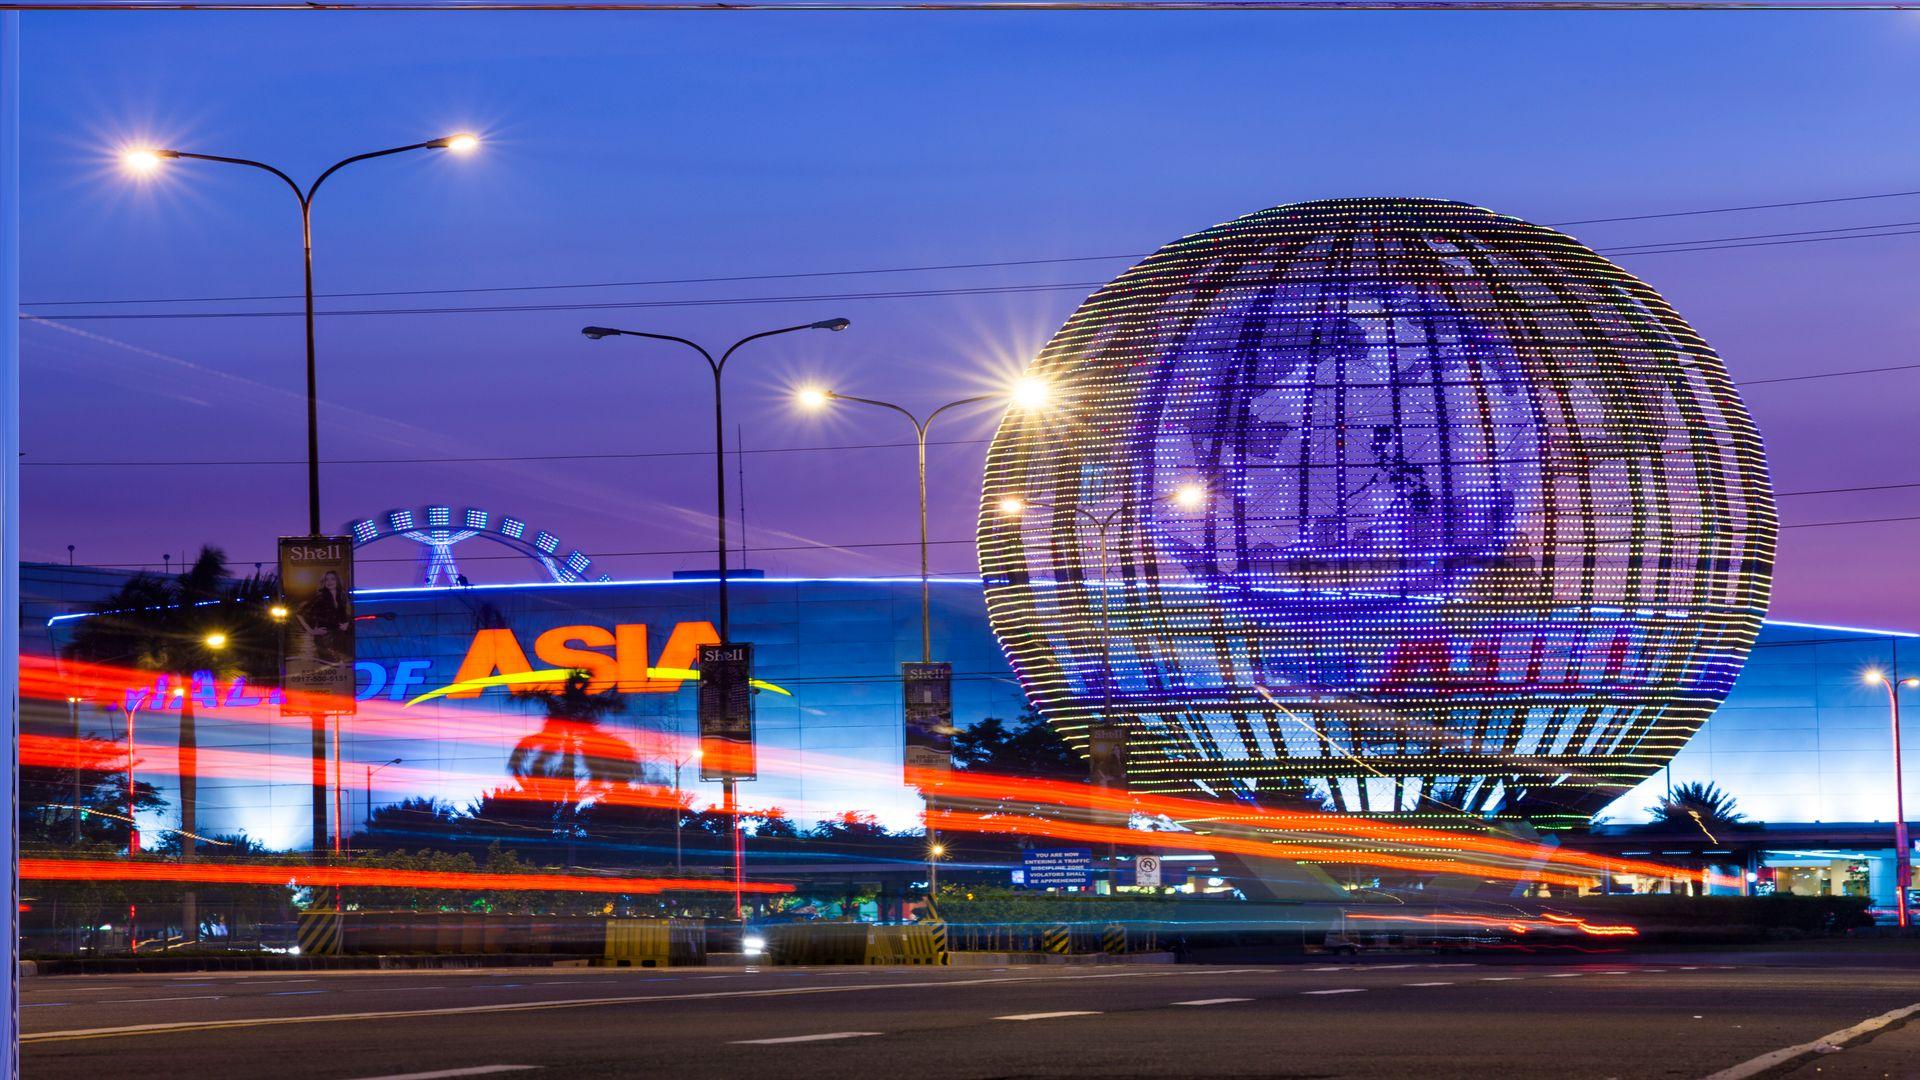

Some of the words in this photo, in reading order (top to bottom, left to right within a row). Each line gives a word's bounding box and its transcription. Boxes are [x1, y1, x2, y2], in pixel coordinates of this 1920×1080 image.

[290, 545, 342, 560] Shell
[444, 621, 721, 699] ASIA
[704, 649, 744, 662] Shell
[354, 659, 432, 701] OF
[910, 668, 945, 680] Shell
